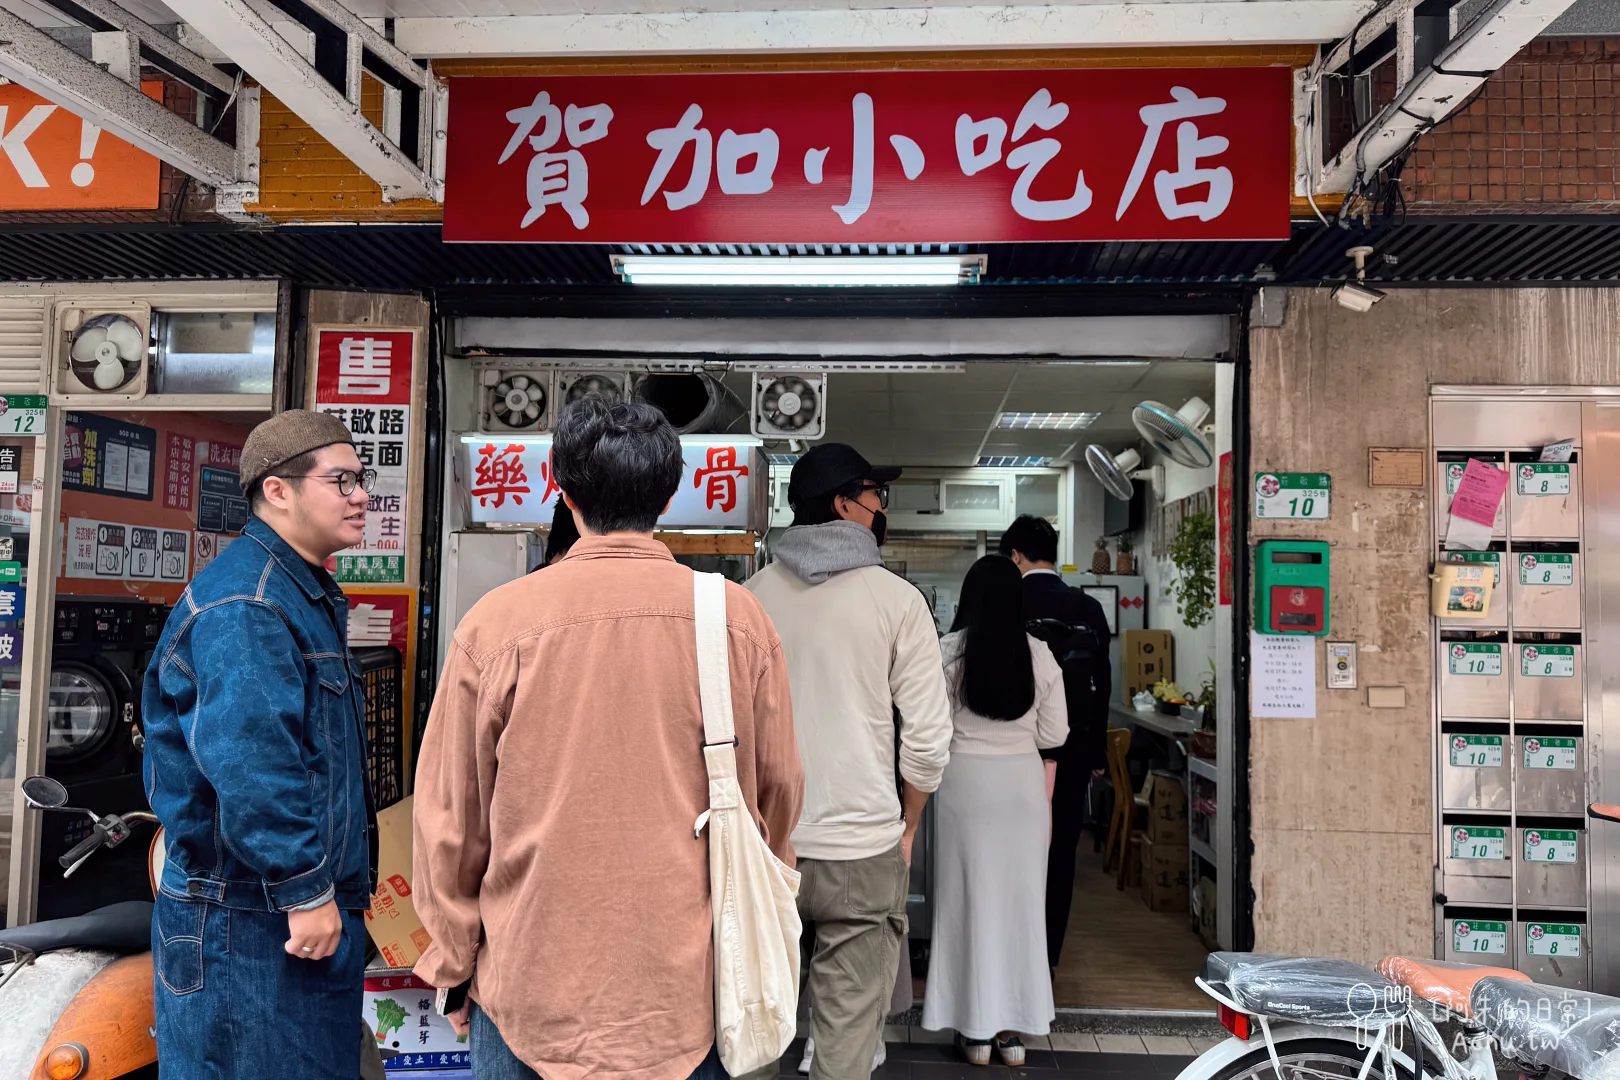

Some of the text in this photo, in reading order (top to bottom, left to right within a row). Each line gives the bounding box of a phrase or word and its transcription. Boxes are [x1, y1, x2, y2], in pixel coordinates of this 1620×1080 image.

[497, 86, 1234, 230] 賀加小吃店
[338, 337, 393, 396] 售
[14, 415, 35, 432] 12
[1540, 480, 1548, 492] 8
[1289, 497, 1315, 516] 10
[381, 516, 400, 536] 生
[341, 556, 399, 569] 信義房屋
[1542, 570, 1551, 582] 8
[1469, 660, 1485, 672] 10
[1544, 662, 1552, 674] 8
[1470, 752, 1486, 765] 10
[1546, 754, 1554, 767] 8
[1471, 845, 1488, 857] 10
[1547, 847, 1555, 860] 8
[1473, 939, 1489, 951] 10
[1550, 942, 1558, 954] 8
[1291, 1003, 1311, 1011] Sports
